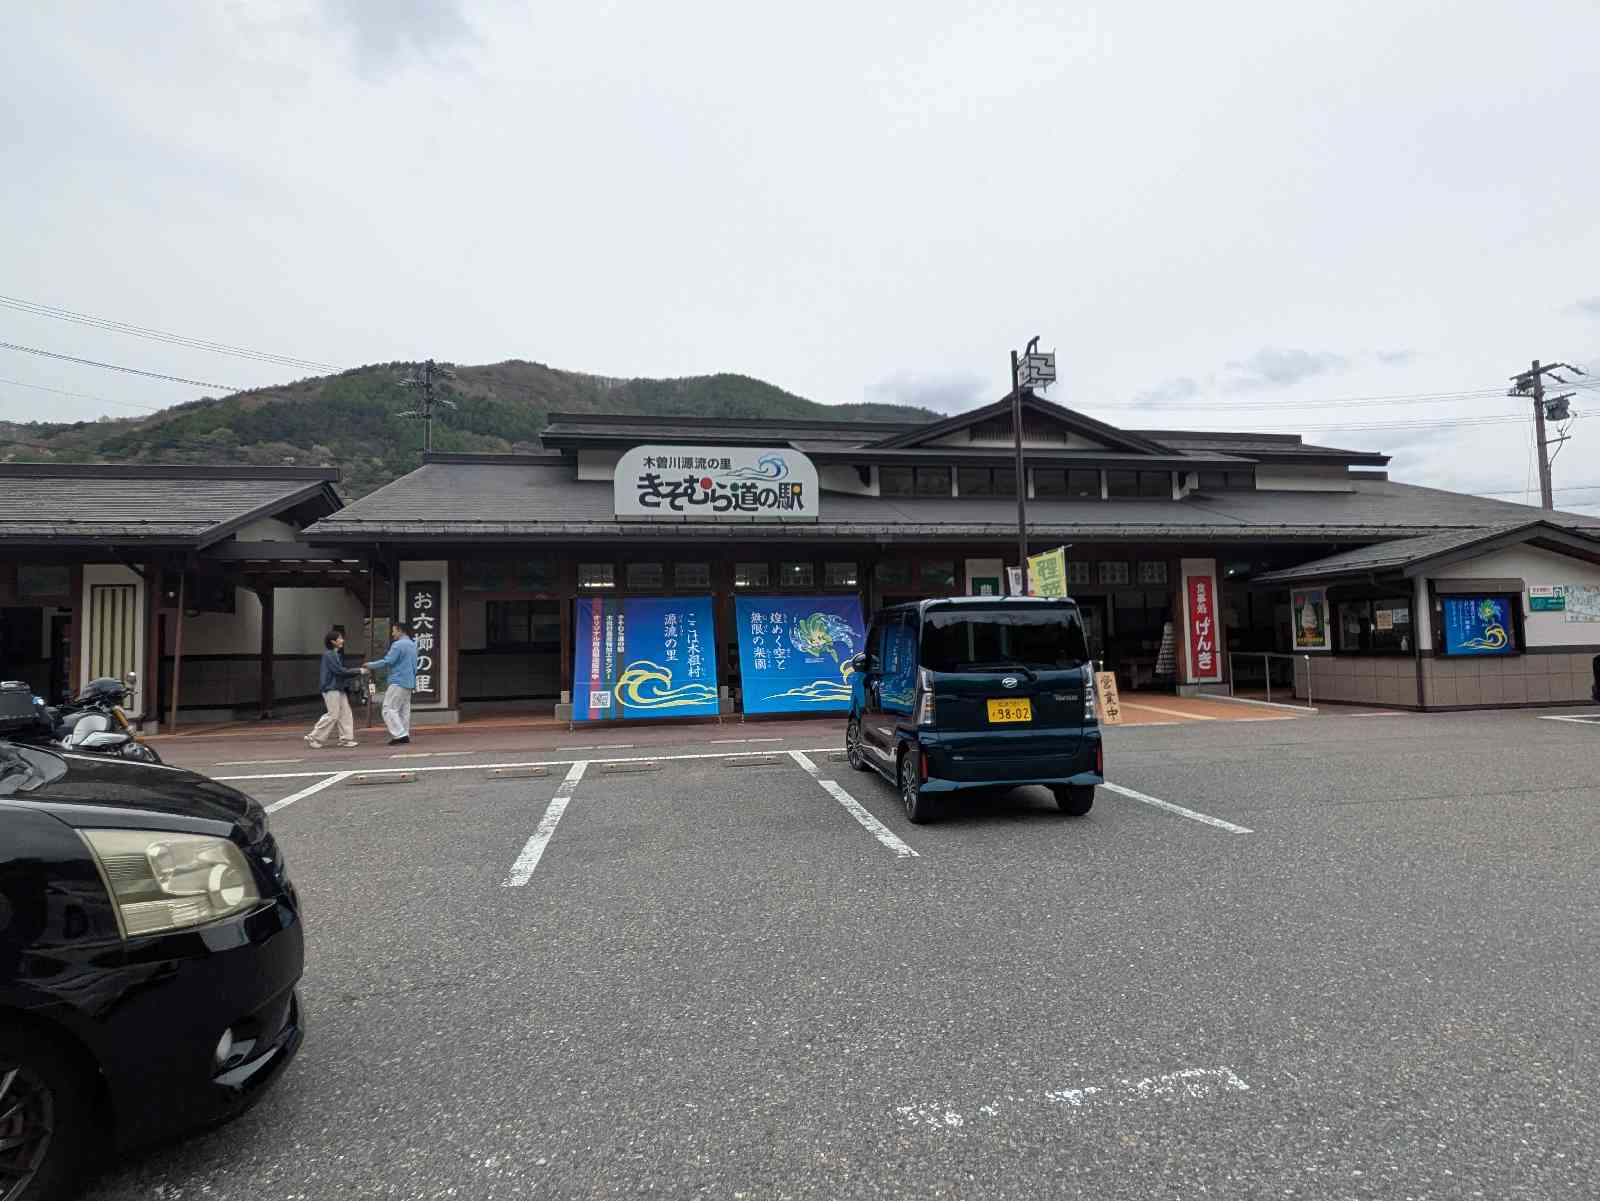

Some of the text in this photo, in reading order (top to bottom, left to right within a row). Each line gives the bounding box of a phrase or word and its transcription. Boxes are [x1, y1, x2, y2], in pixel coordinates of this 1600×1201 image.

[643, 456, 731, 470] 木曽川源流の里
[637, 473, 804, 511] きそむら道の駅
[664, 613, 679, 662] 源流の里
